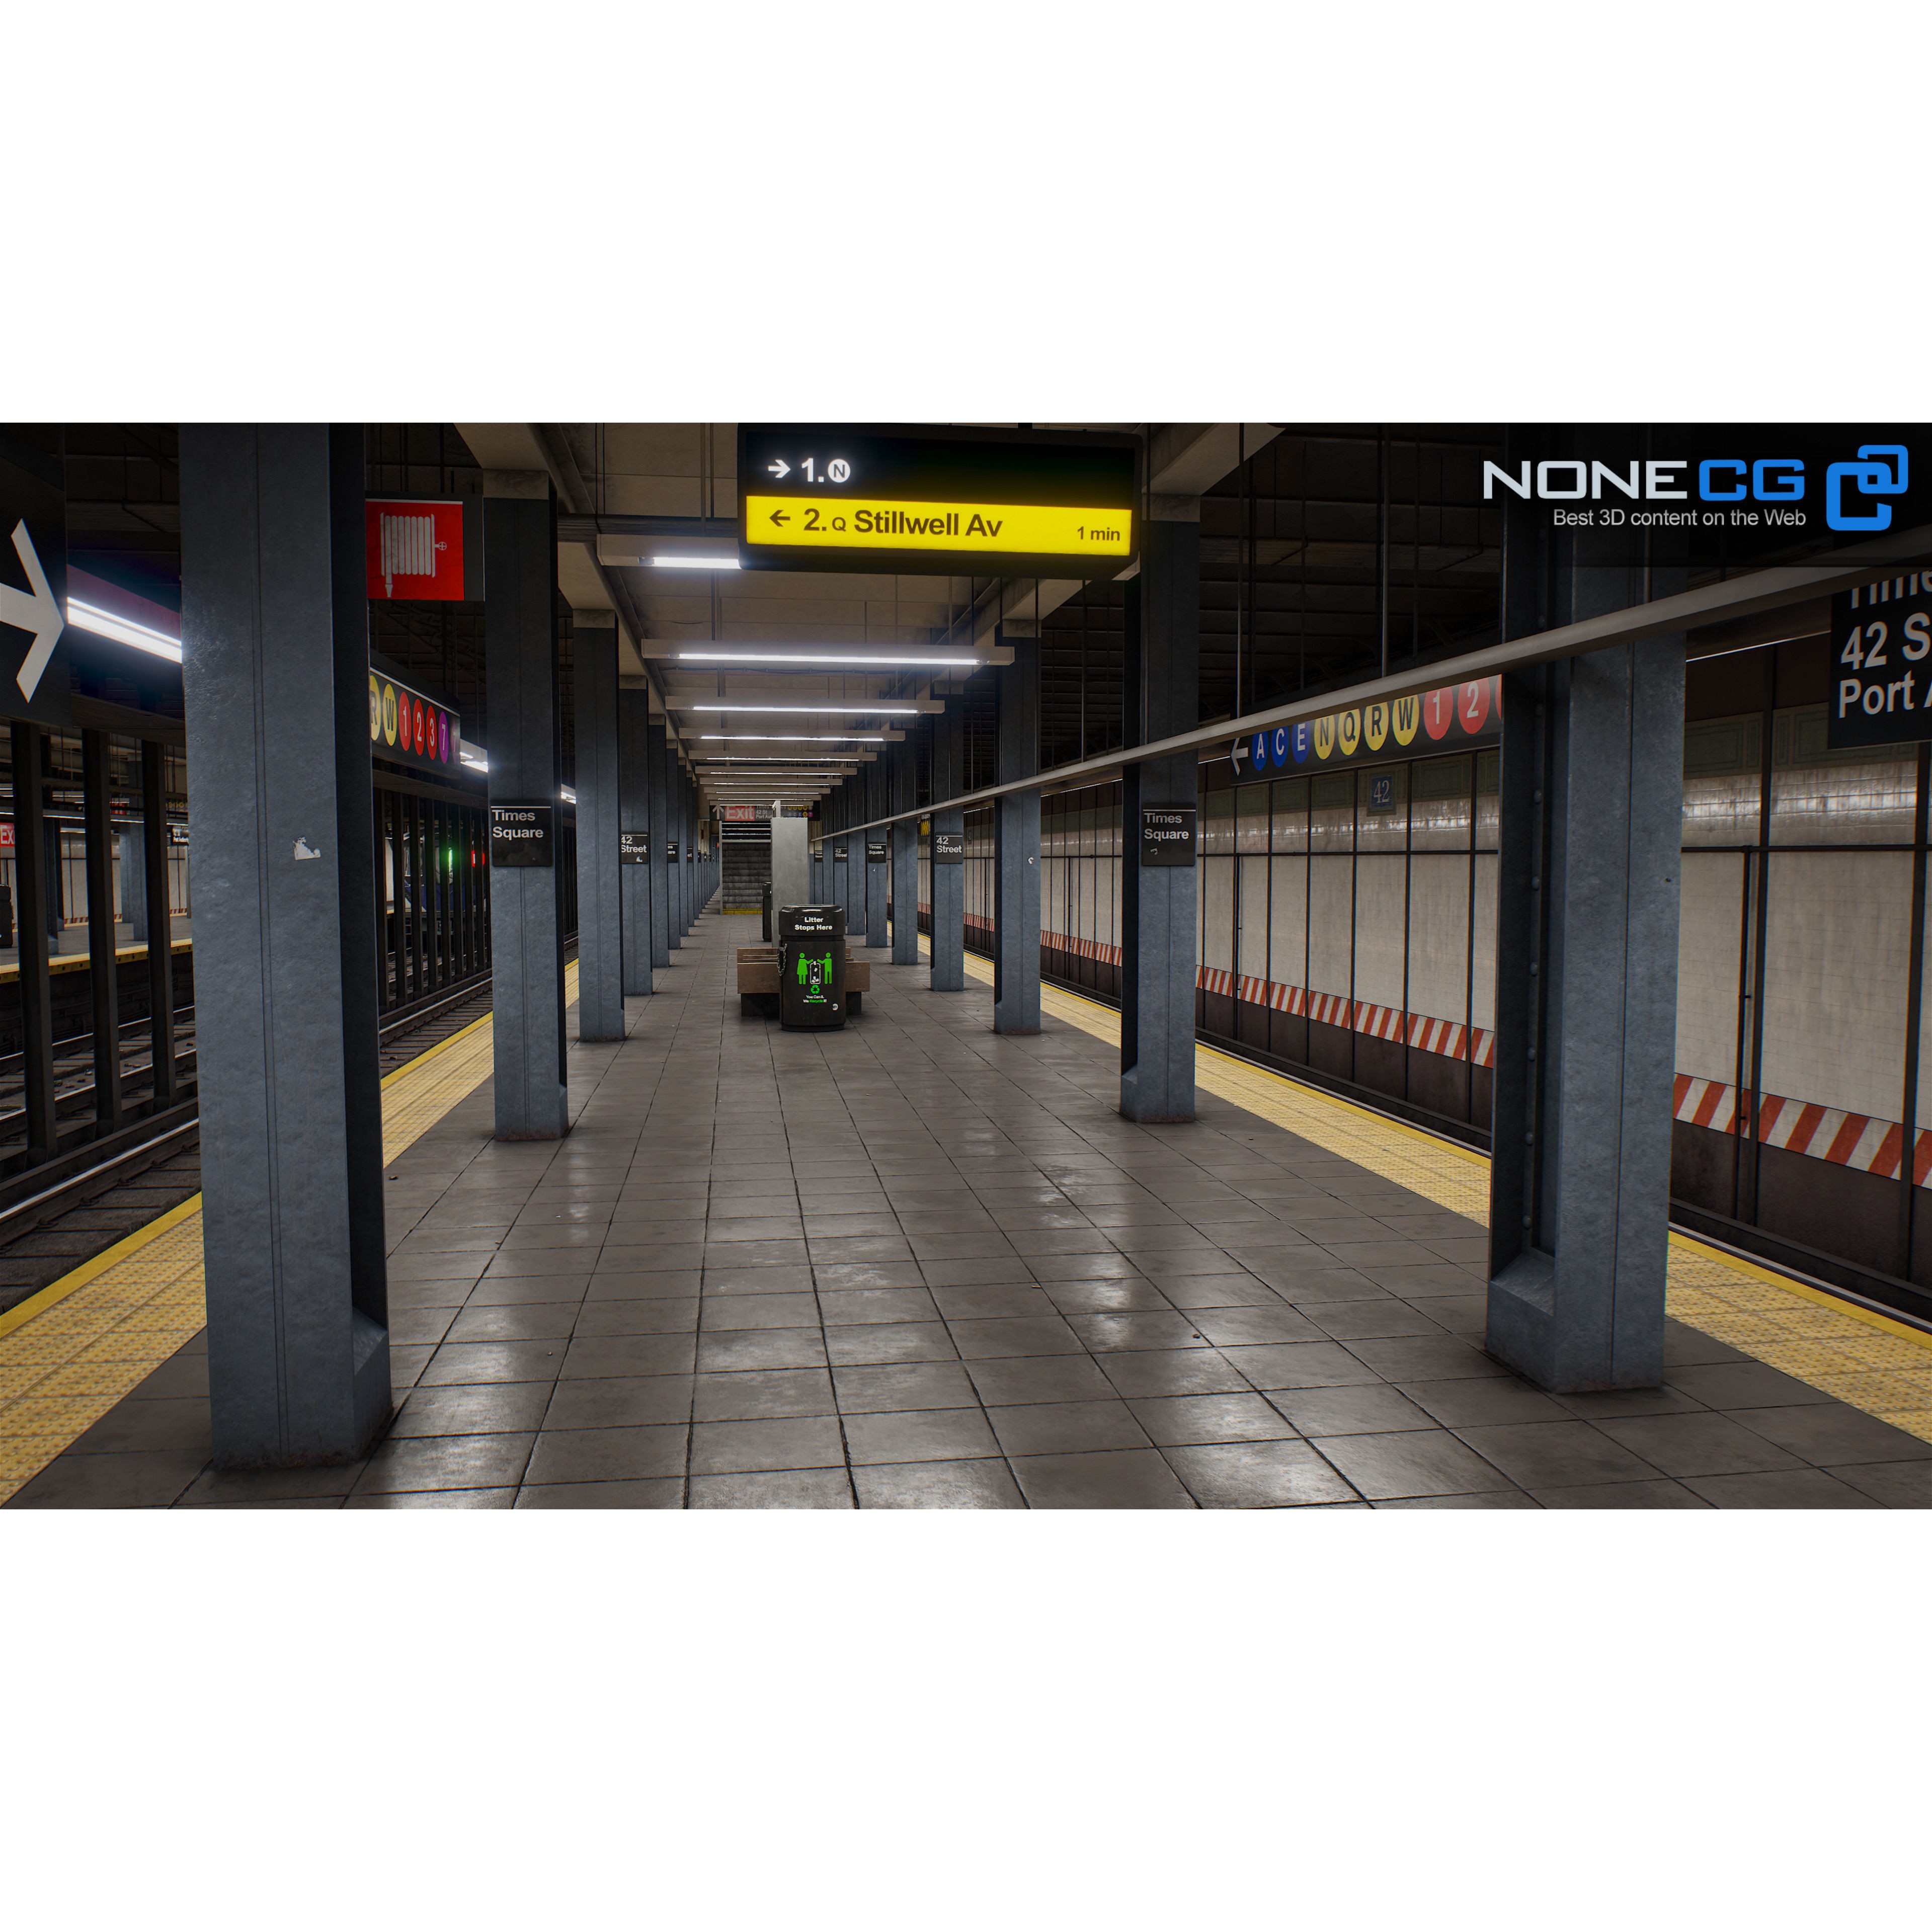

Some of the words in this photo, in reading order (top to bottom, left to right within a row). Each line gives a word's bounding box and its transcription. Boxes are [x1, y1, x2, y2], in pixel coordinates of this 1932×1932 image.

[801, 457, 825, 482] 1.
[803, 508, 827, 531] 2.
[832, 517, 847, 532] Q
[854, 509, 959, 536] Stillwell
[964, 514, 1003, 537] Av
[1077, 526, 1084, 540] 1
[1090, 527, 1120, 541] min
[1840, 621, 1888, 670] 42
[1838, 670, 1915, 719] Port
[385, 697, 394, 732] W
[403, 705, 408, 737] 1
[417, 711, 422, 742] 2
[429, 717, 435, 747] 3
[441, 723, 446, 751] 7
[1256, 733, 1265, 760] A
[1275, 728, 1285, 756] C
[1297, 722, 1307, 752] E
[1319, 716, 1330, 747] N
[1344, 711, 1356, 743] Q
[1371, 705, 1383, 738] R
[1398, 697, 1415, 732] W
[1432, 690, 1441, 725] 1
[1467, 681, 1479, 719] 2
[1374, 780, 1390, 804] 42
[492, 810, 536, 821] Times
[726, 806, 754, 819] Exit
[1144, 813, 1183, 823] Times
[492, 826, 544, 841] Square
[621, 836, 632, 844] 42
[1144, 828, 1189, 842] Square
[936, 837, 949, 845] 42
[621, 845, 647, 853] Street
[936, 845, 962, 853] Street
